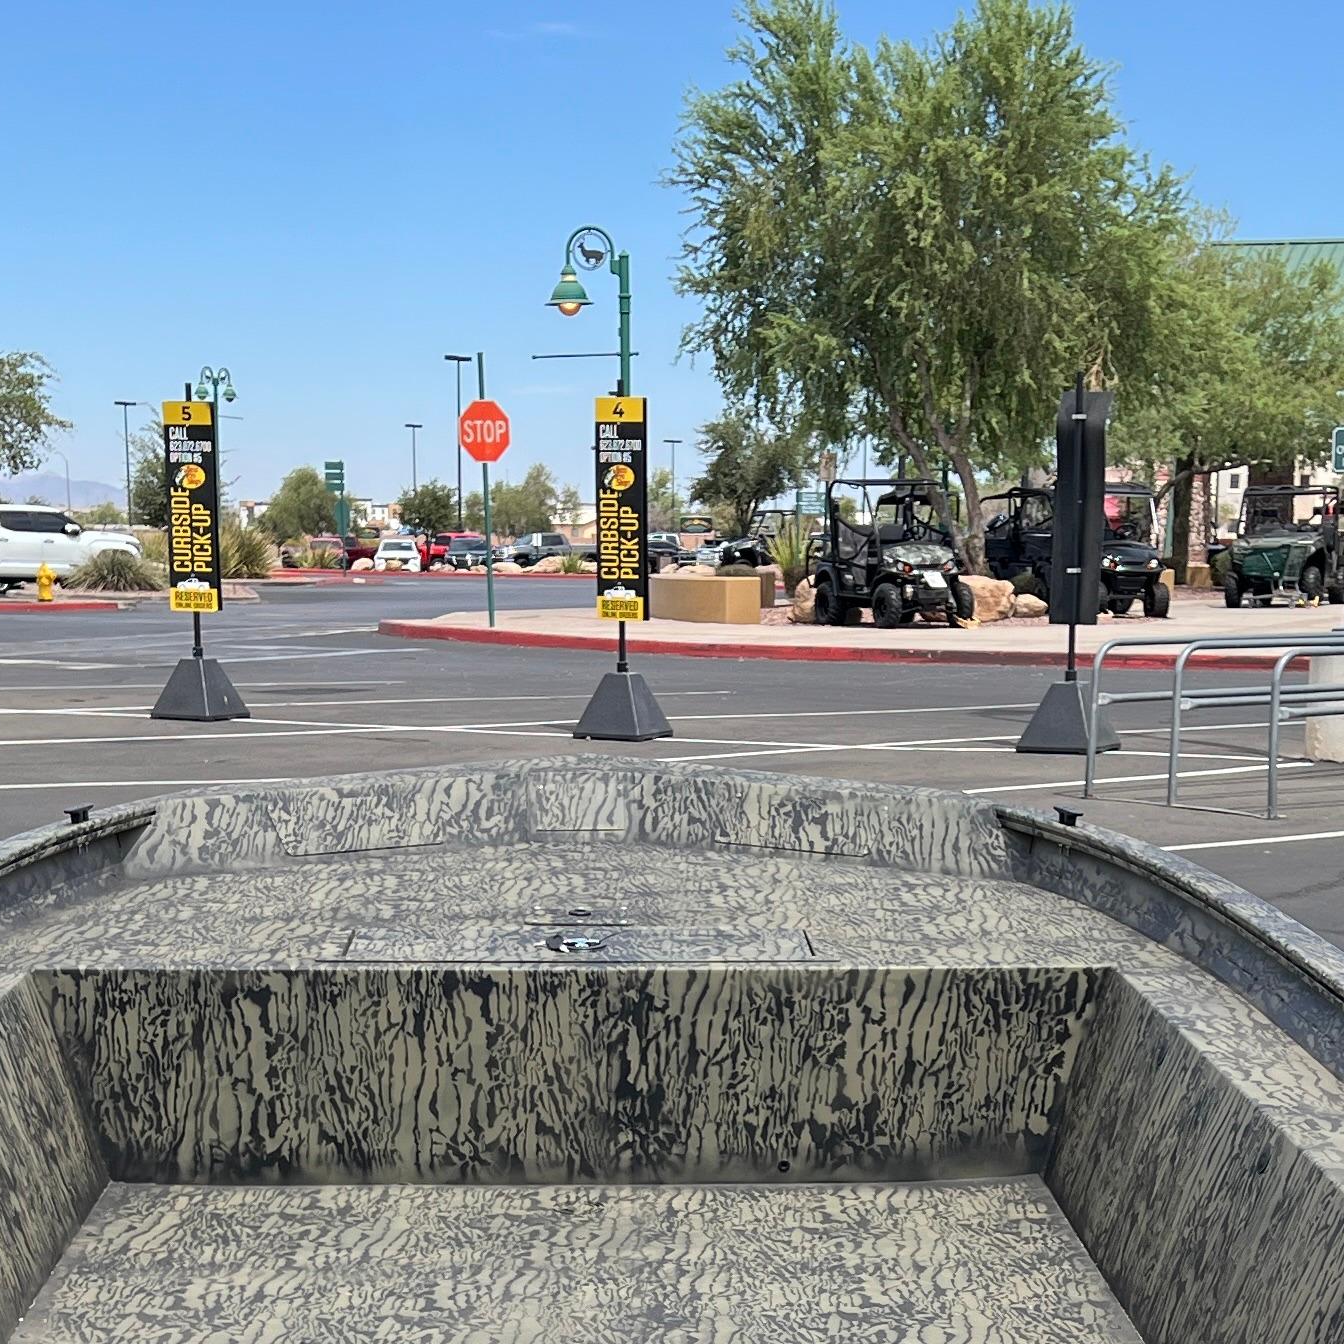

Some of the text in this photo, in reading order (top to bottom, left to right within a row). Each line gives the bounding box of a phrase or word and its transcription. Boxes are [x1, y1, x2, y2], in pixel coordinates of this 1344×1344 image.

[181, 405, 192, 421] 5
[612, 401, 625, 418] 4
[169, 426, 188, 440] CALL
[463, 420, 506, 443] STOP
[599, 424, 618, 438] CALL
[170, 487, 192, 572] CURBSIDE
[191, 504, 213, 572] PICK-UP
[599, 488, 619, 579] CURBSIDE
[619, 506, 639, 579] PICK-UP
[175, 591, 213, 602] RESERVED
[602, 600, 638, 611] RESERVED
